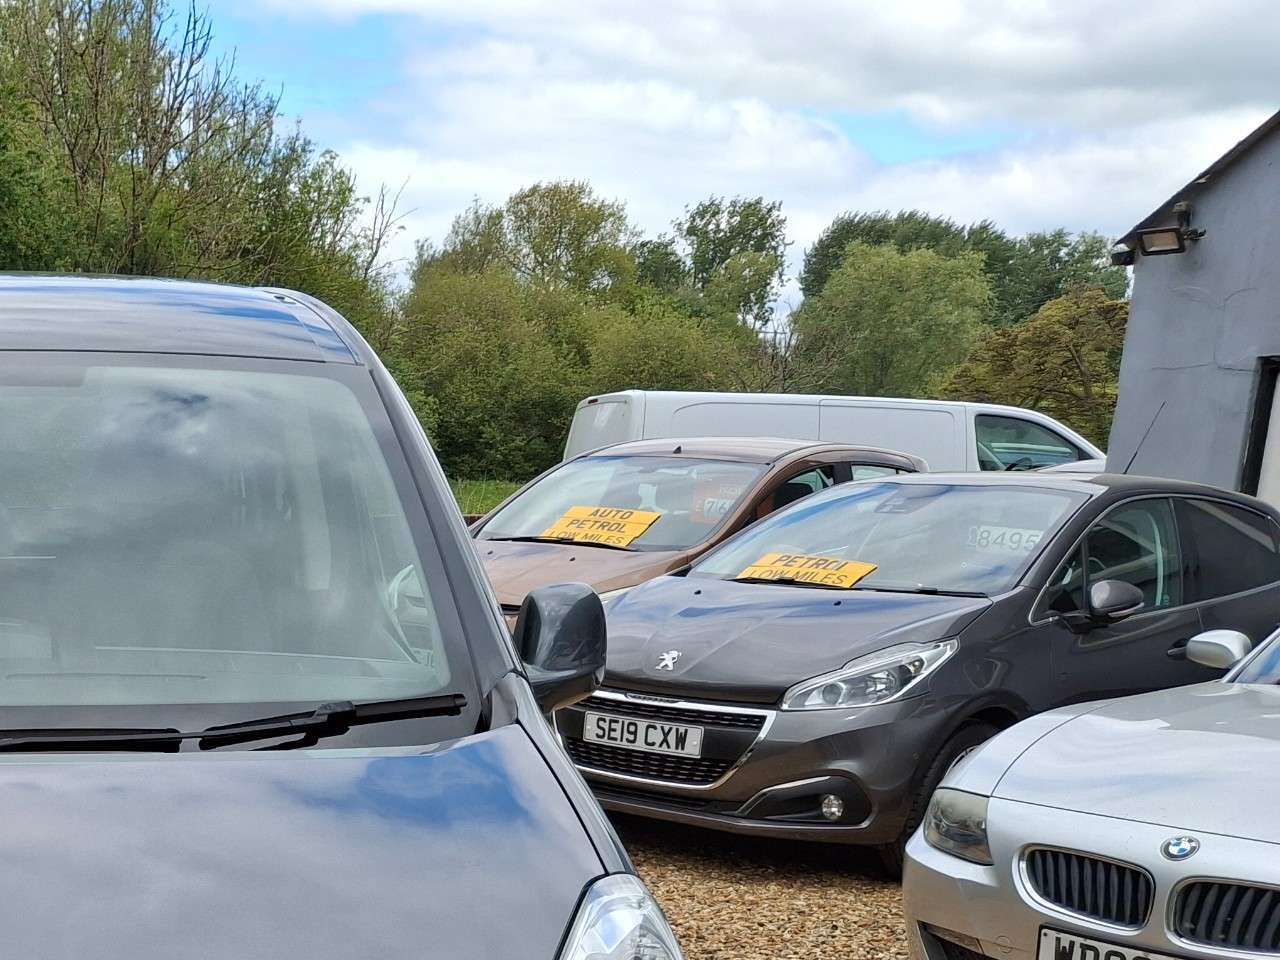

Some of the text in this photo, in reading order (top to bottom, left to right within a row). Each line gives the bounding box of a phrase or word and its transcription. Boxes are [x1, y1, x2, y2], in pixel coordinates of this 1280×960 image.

[588, 508, 634, 520] AUTO
[565, 519, 627, 534] PETROL
[580, 532, 625, 545] MILES
[793, 571, 849, 585] MILES
[595, 717, 689, 751] SE19 CXW
